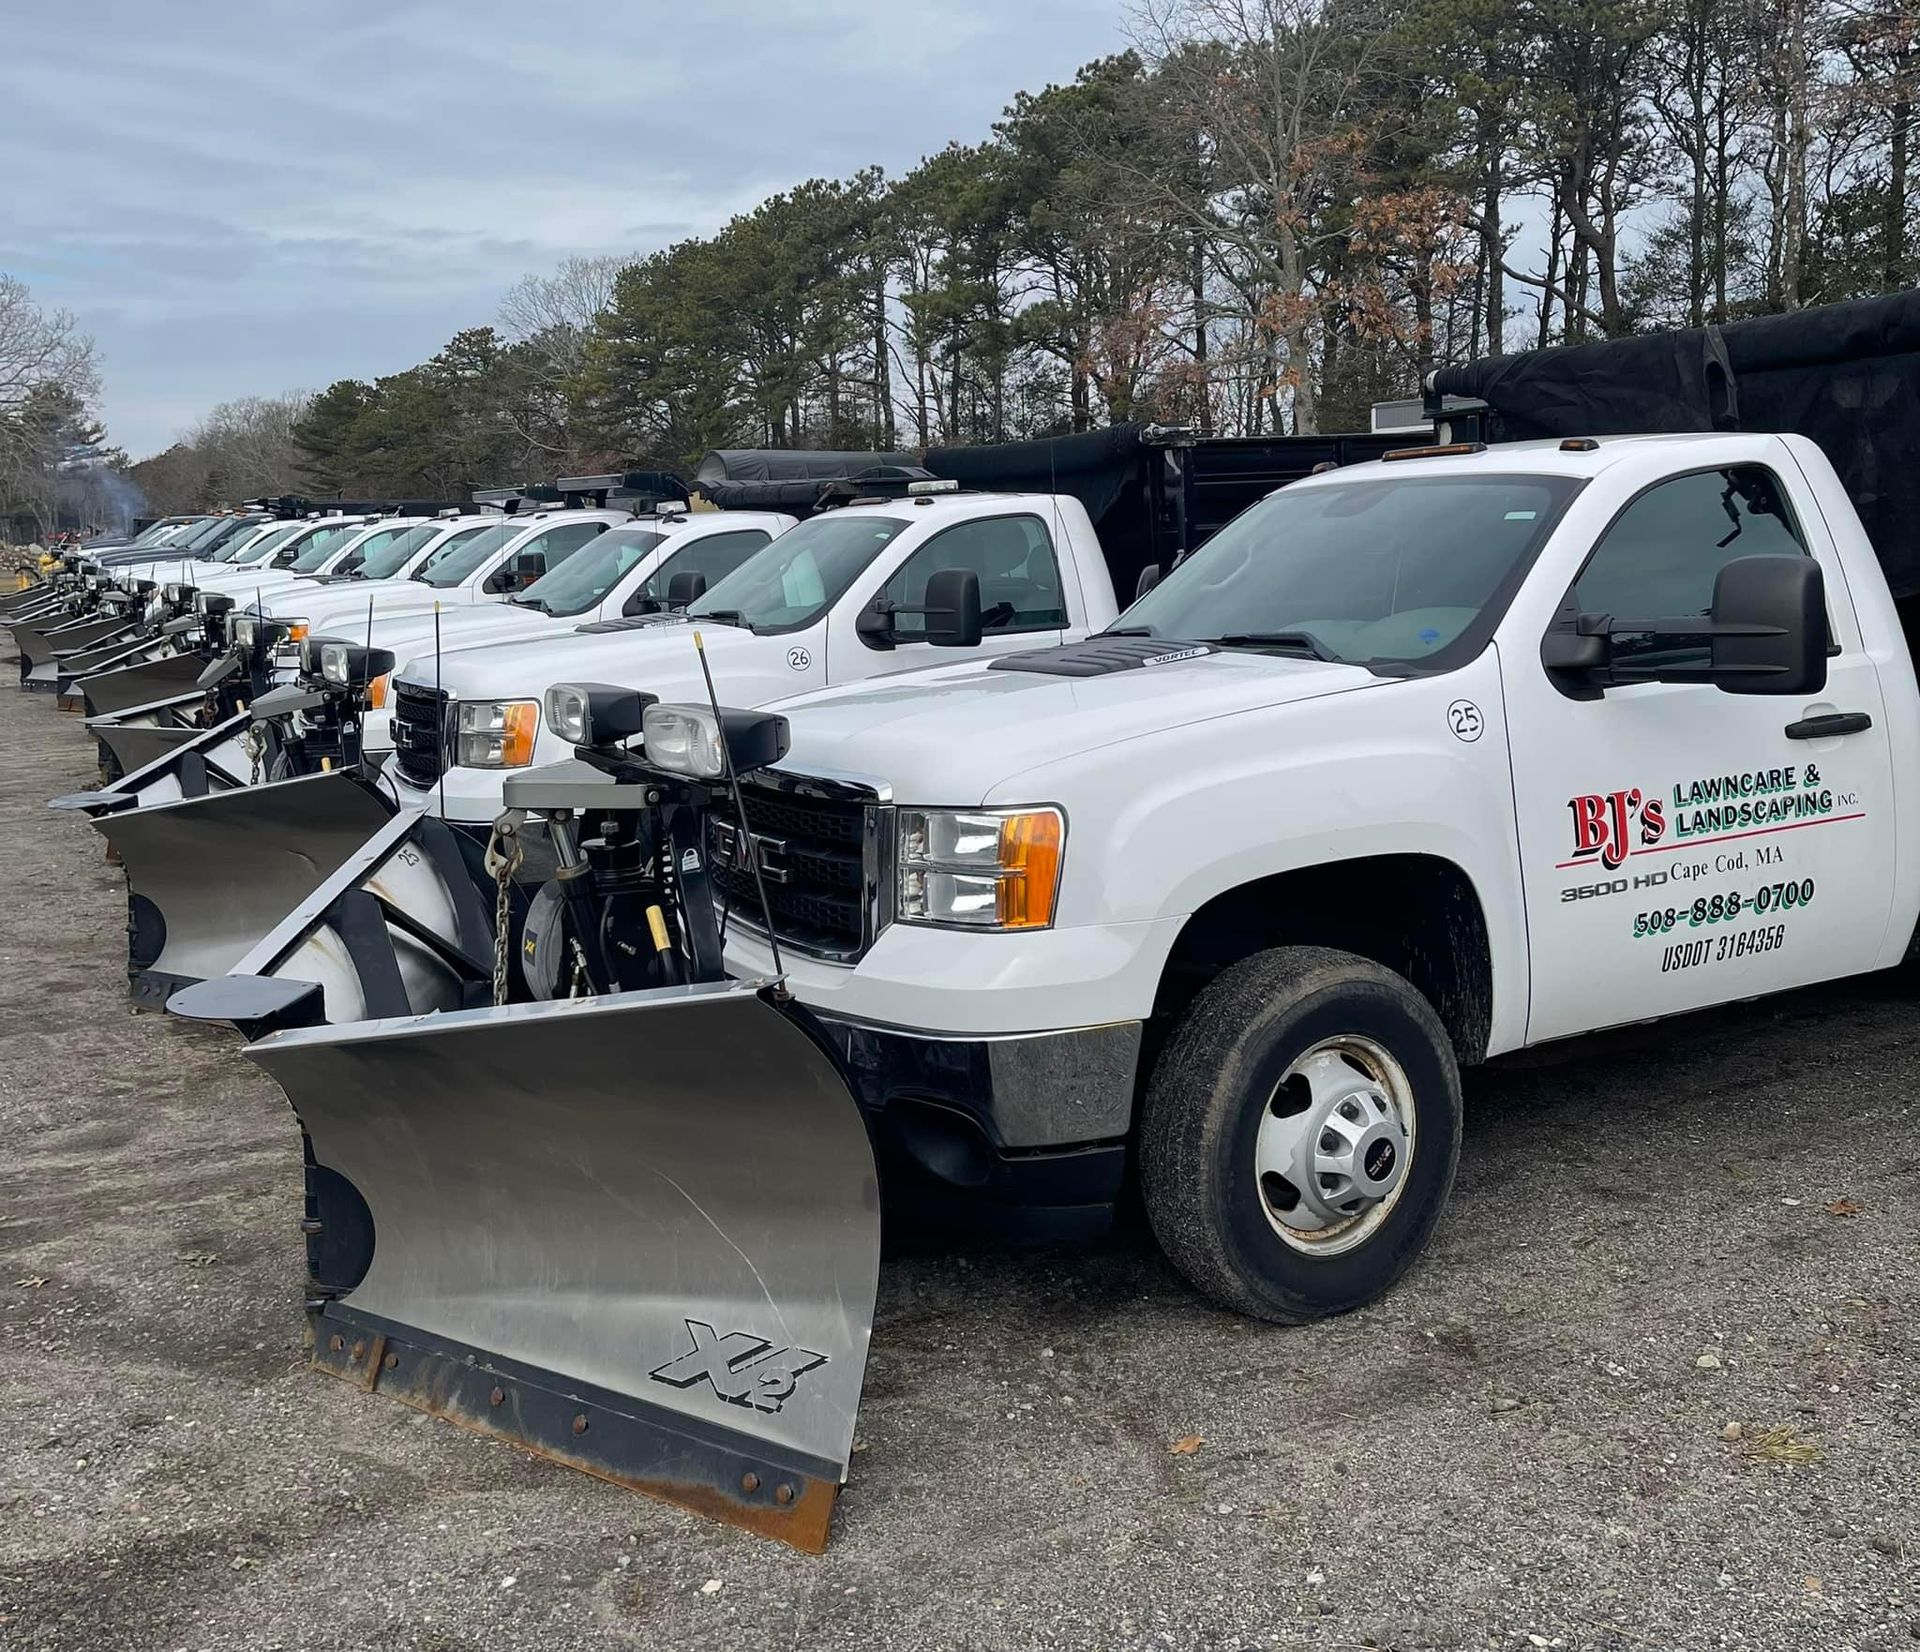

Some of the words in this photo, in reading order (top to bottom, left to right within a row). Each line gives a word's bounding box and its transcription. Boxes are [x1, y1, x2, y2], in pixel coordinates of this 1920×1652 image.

[789, 651, 809, 666] 26
[1153, 648, 1200, 663] VORTEC
[1451, 706, 1479, 734] 25
[1673, 766, 1797, 808] LAWNCARE
[1803, 763, 1821, 788] &
[1567, 787, 1667, 871] BJ's
[1676, 789, 1833, 838] LANDSCAPING
[1837, 792, 1860, 808] INC.
[398, 848, 421, 868] 25
[1670, 861, 1709, 881] Cape
[1715, 852, 1749, 872] Cod,
[1755, 845, 1785, 867] MA
[1560, 878, 1629, 903] 3500
[1633, 871, 1669, 890] HD
[1633, 878, 1816, 939] 508-888-0700
[1661, 938, 1714, 973] USDOT
[1716, 924, 1786, 962] 3164356
